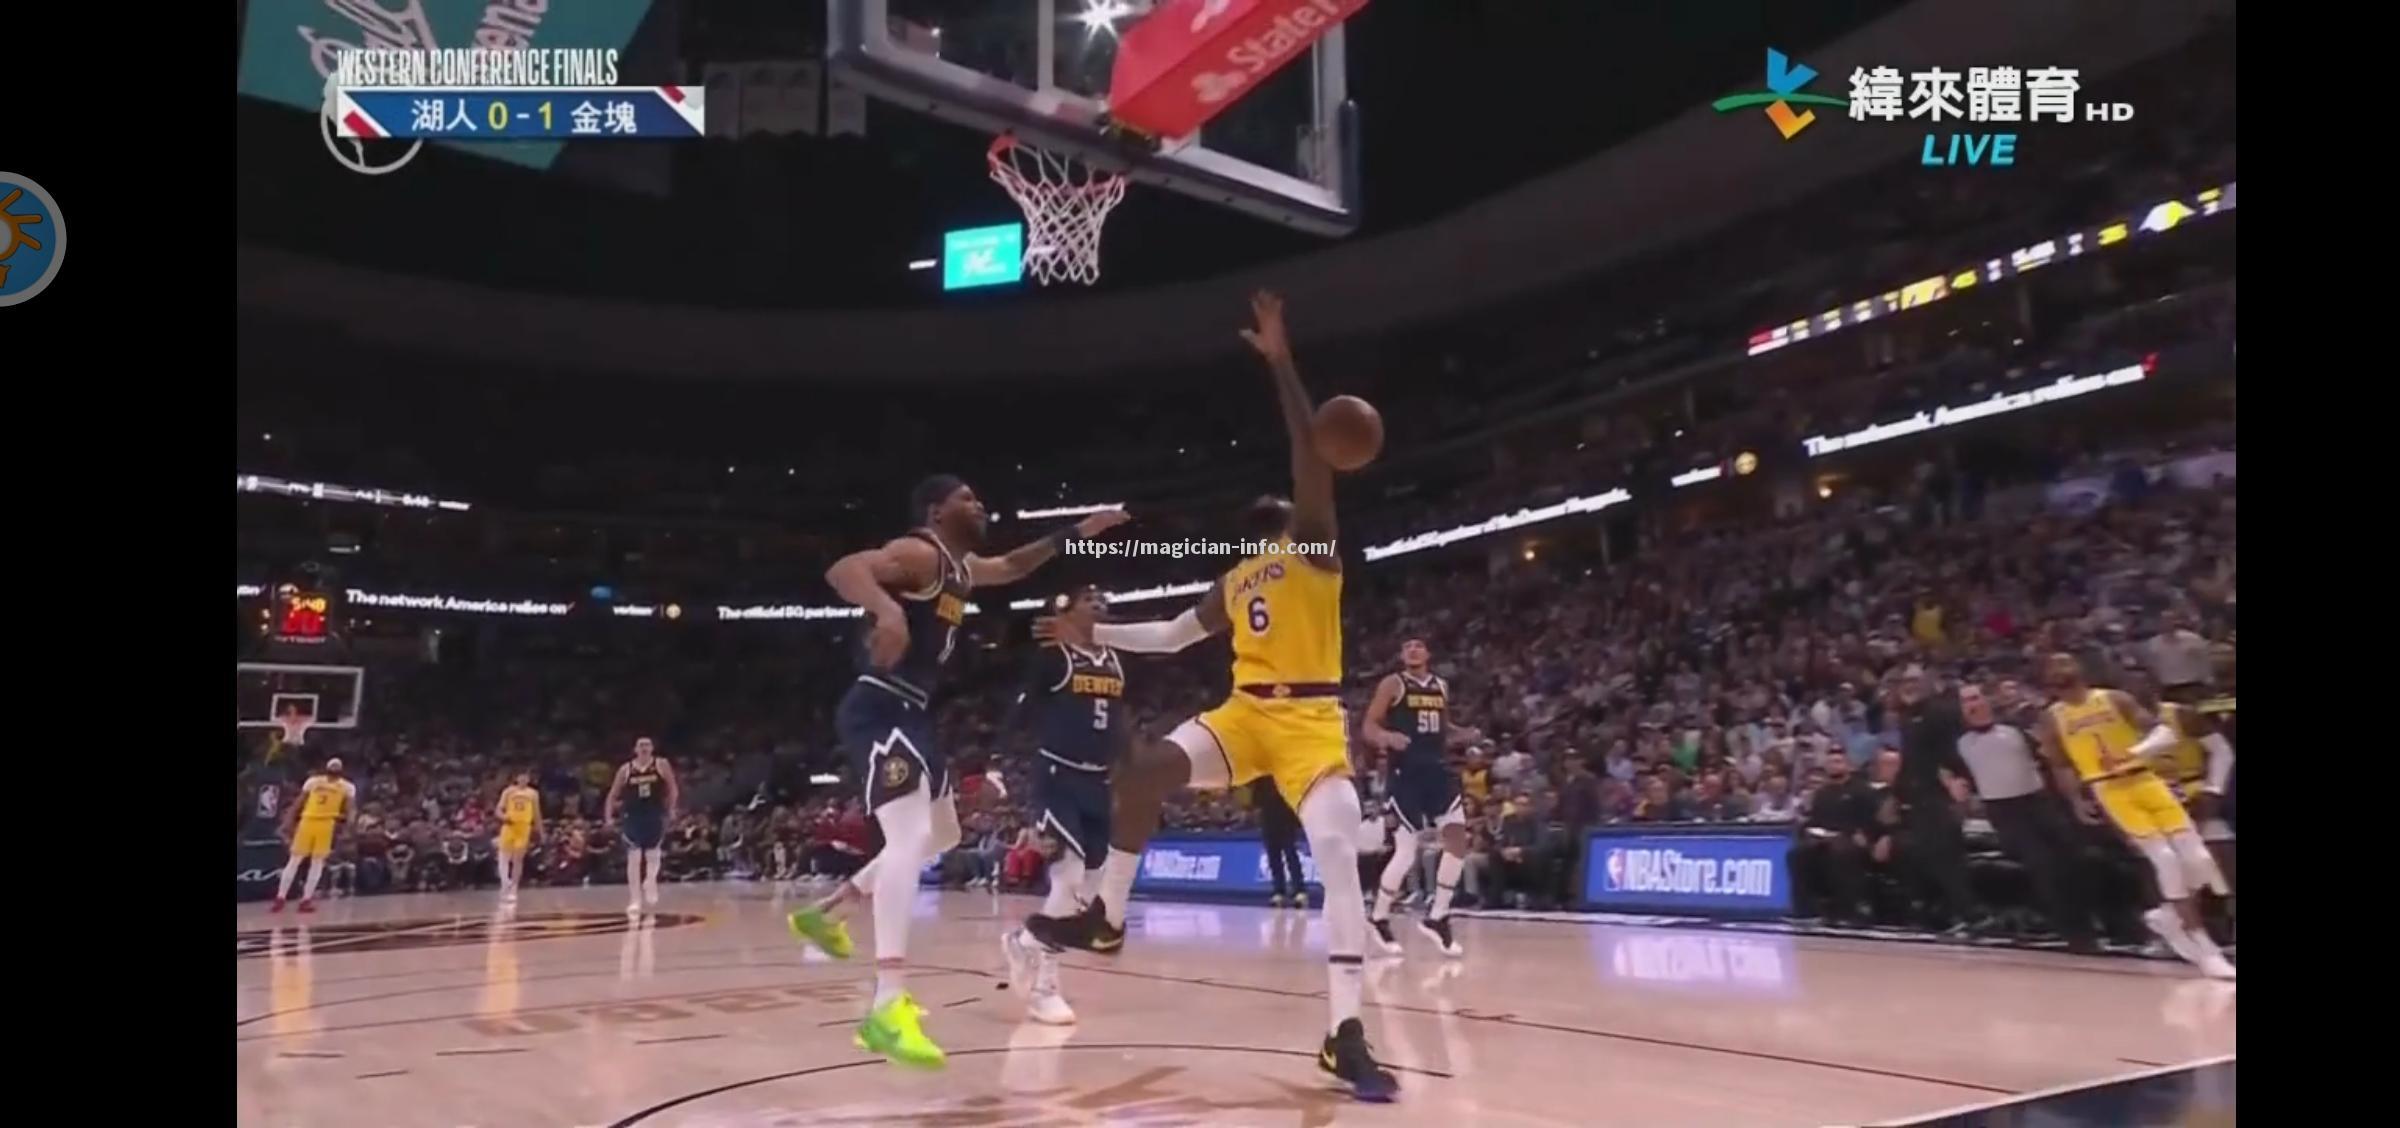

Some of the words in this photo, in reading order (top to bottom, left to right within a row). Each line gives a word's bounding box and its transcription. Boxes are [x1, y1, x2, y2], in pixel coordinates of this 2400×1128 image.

[346, 589, 378, 605] The
[379, 593, 443, 610] network
[444, 596, 507, 613] America
[1247, 596, 1270, 633] 6
[1093, 698, 1109, 730] 5
[1417, 709, 1440, 734] 50
[1625, 849, 1773, 896] NBAStore.com
